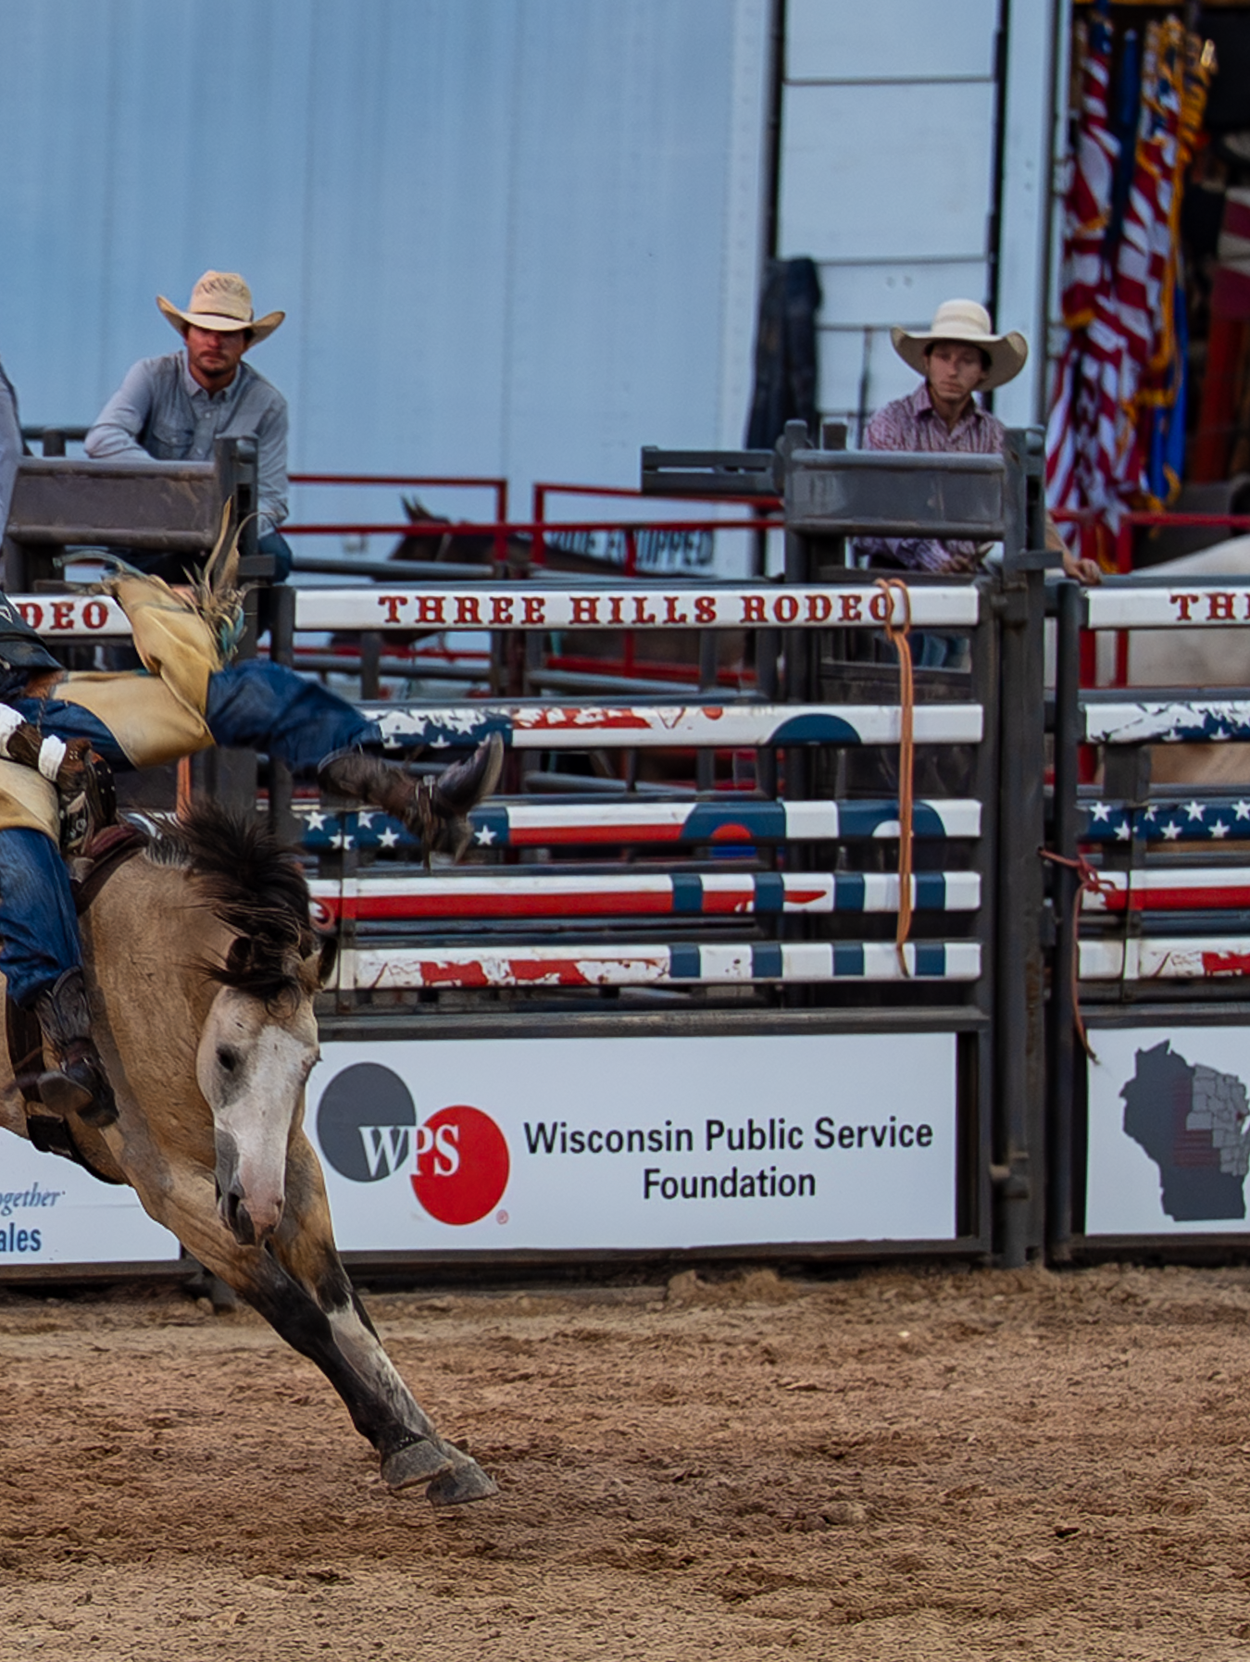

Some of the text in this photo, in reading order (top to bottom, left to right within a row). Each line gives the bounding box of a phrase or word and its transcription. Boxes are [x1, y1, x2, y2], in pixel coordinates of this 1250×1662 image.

[20, 602, 109, 629] DEO
[379, 594, 895, 624] THREE HILLS RODEO
[1169, 592, 1250, 621] TH
[359, 1124, 460, 1178] WPS
[523, 1115, 934, 1155] Wisconsin Public Service
[643, 1165, 817, 1200] Foundation
